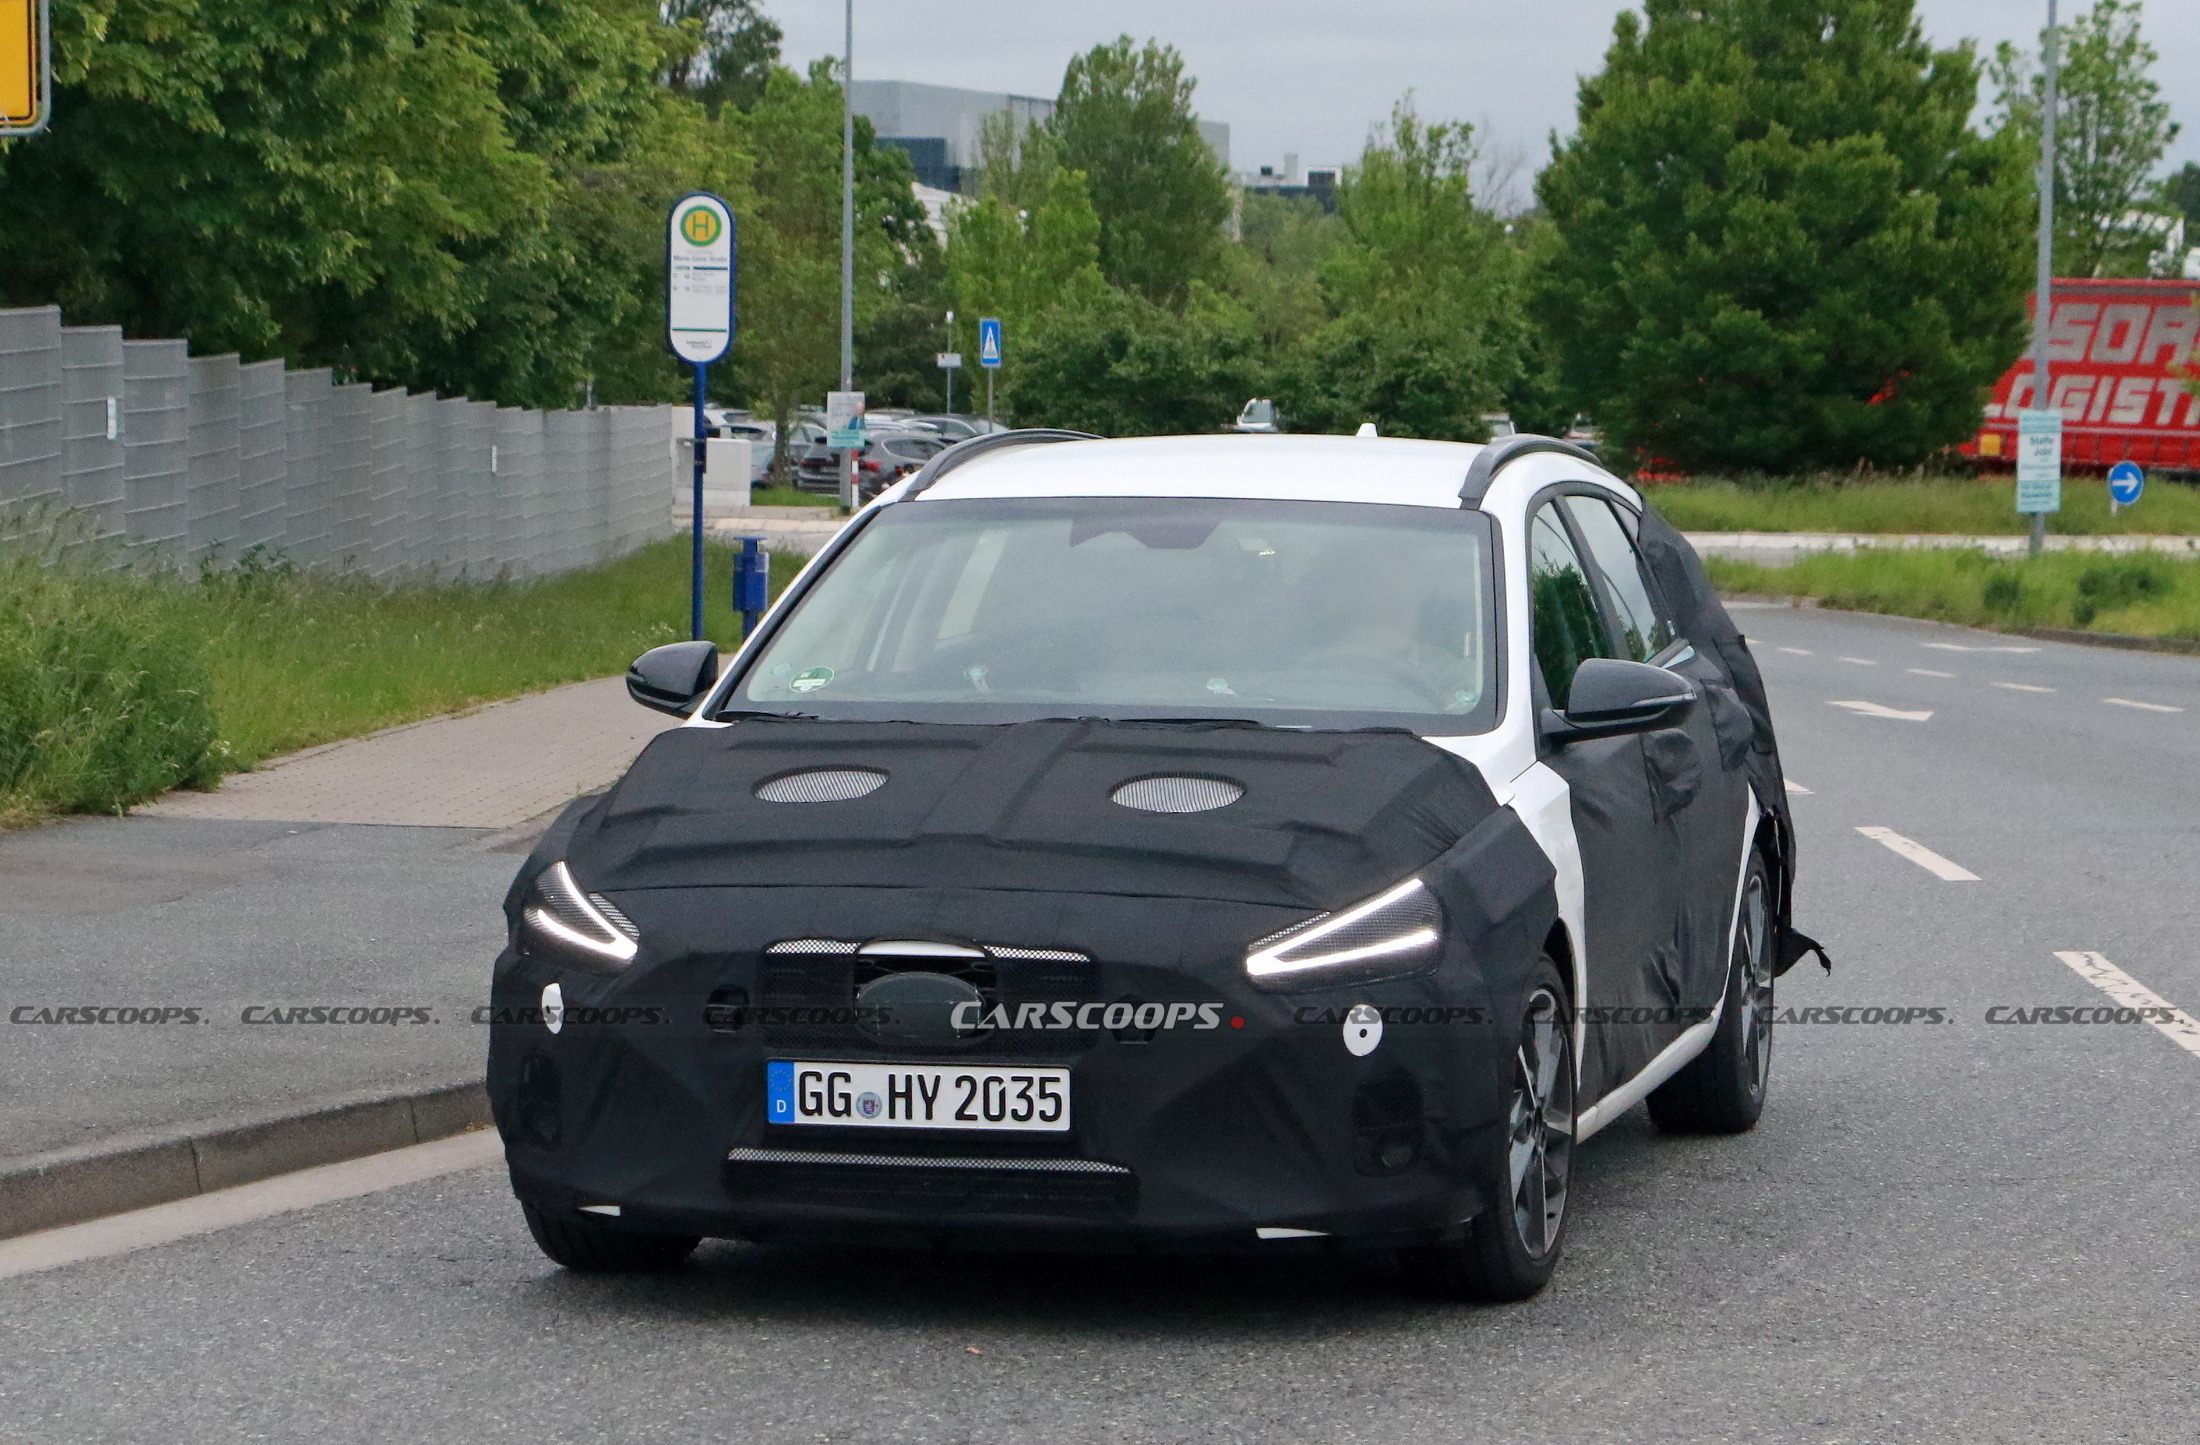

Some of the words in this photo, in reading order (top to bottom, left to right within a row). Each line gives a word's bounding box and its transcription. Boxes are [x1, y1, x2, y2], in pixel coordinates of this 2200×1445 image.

[692, 214, 709, 237] H
[776, 1100, 787, 1113] D
[799, 1070, 852, 1118] GG
[888, 1074, 941, 1121] HY
[955, 1074, 1062, 1123] 2035
